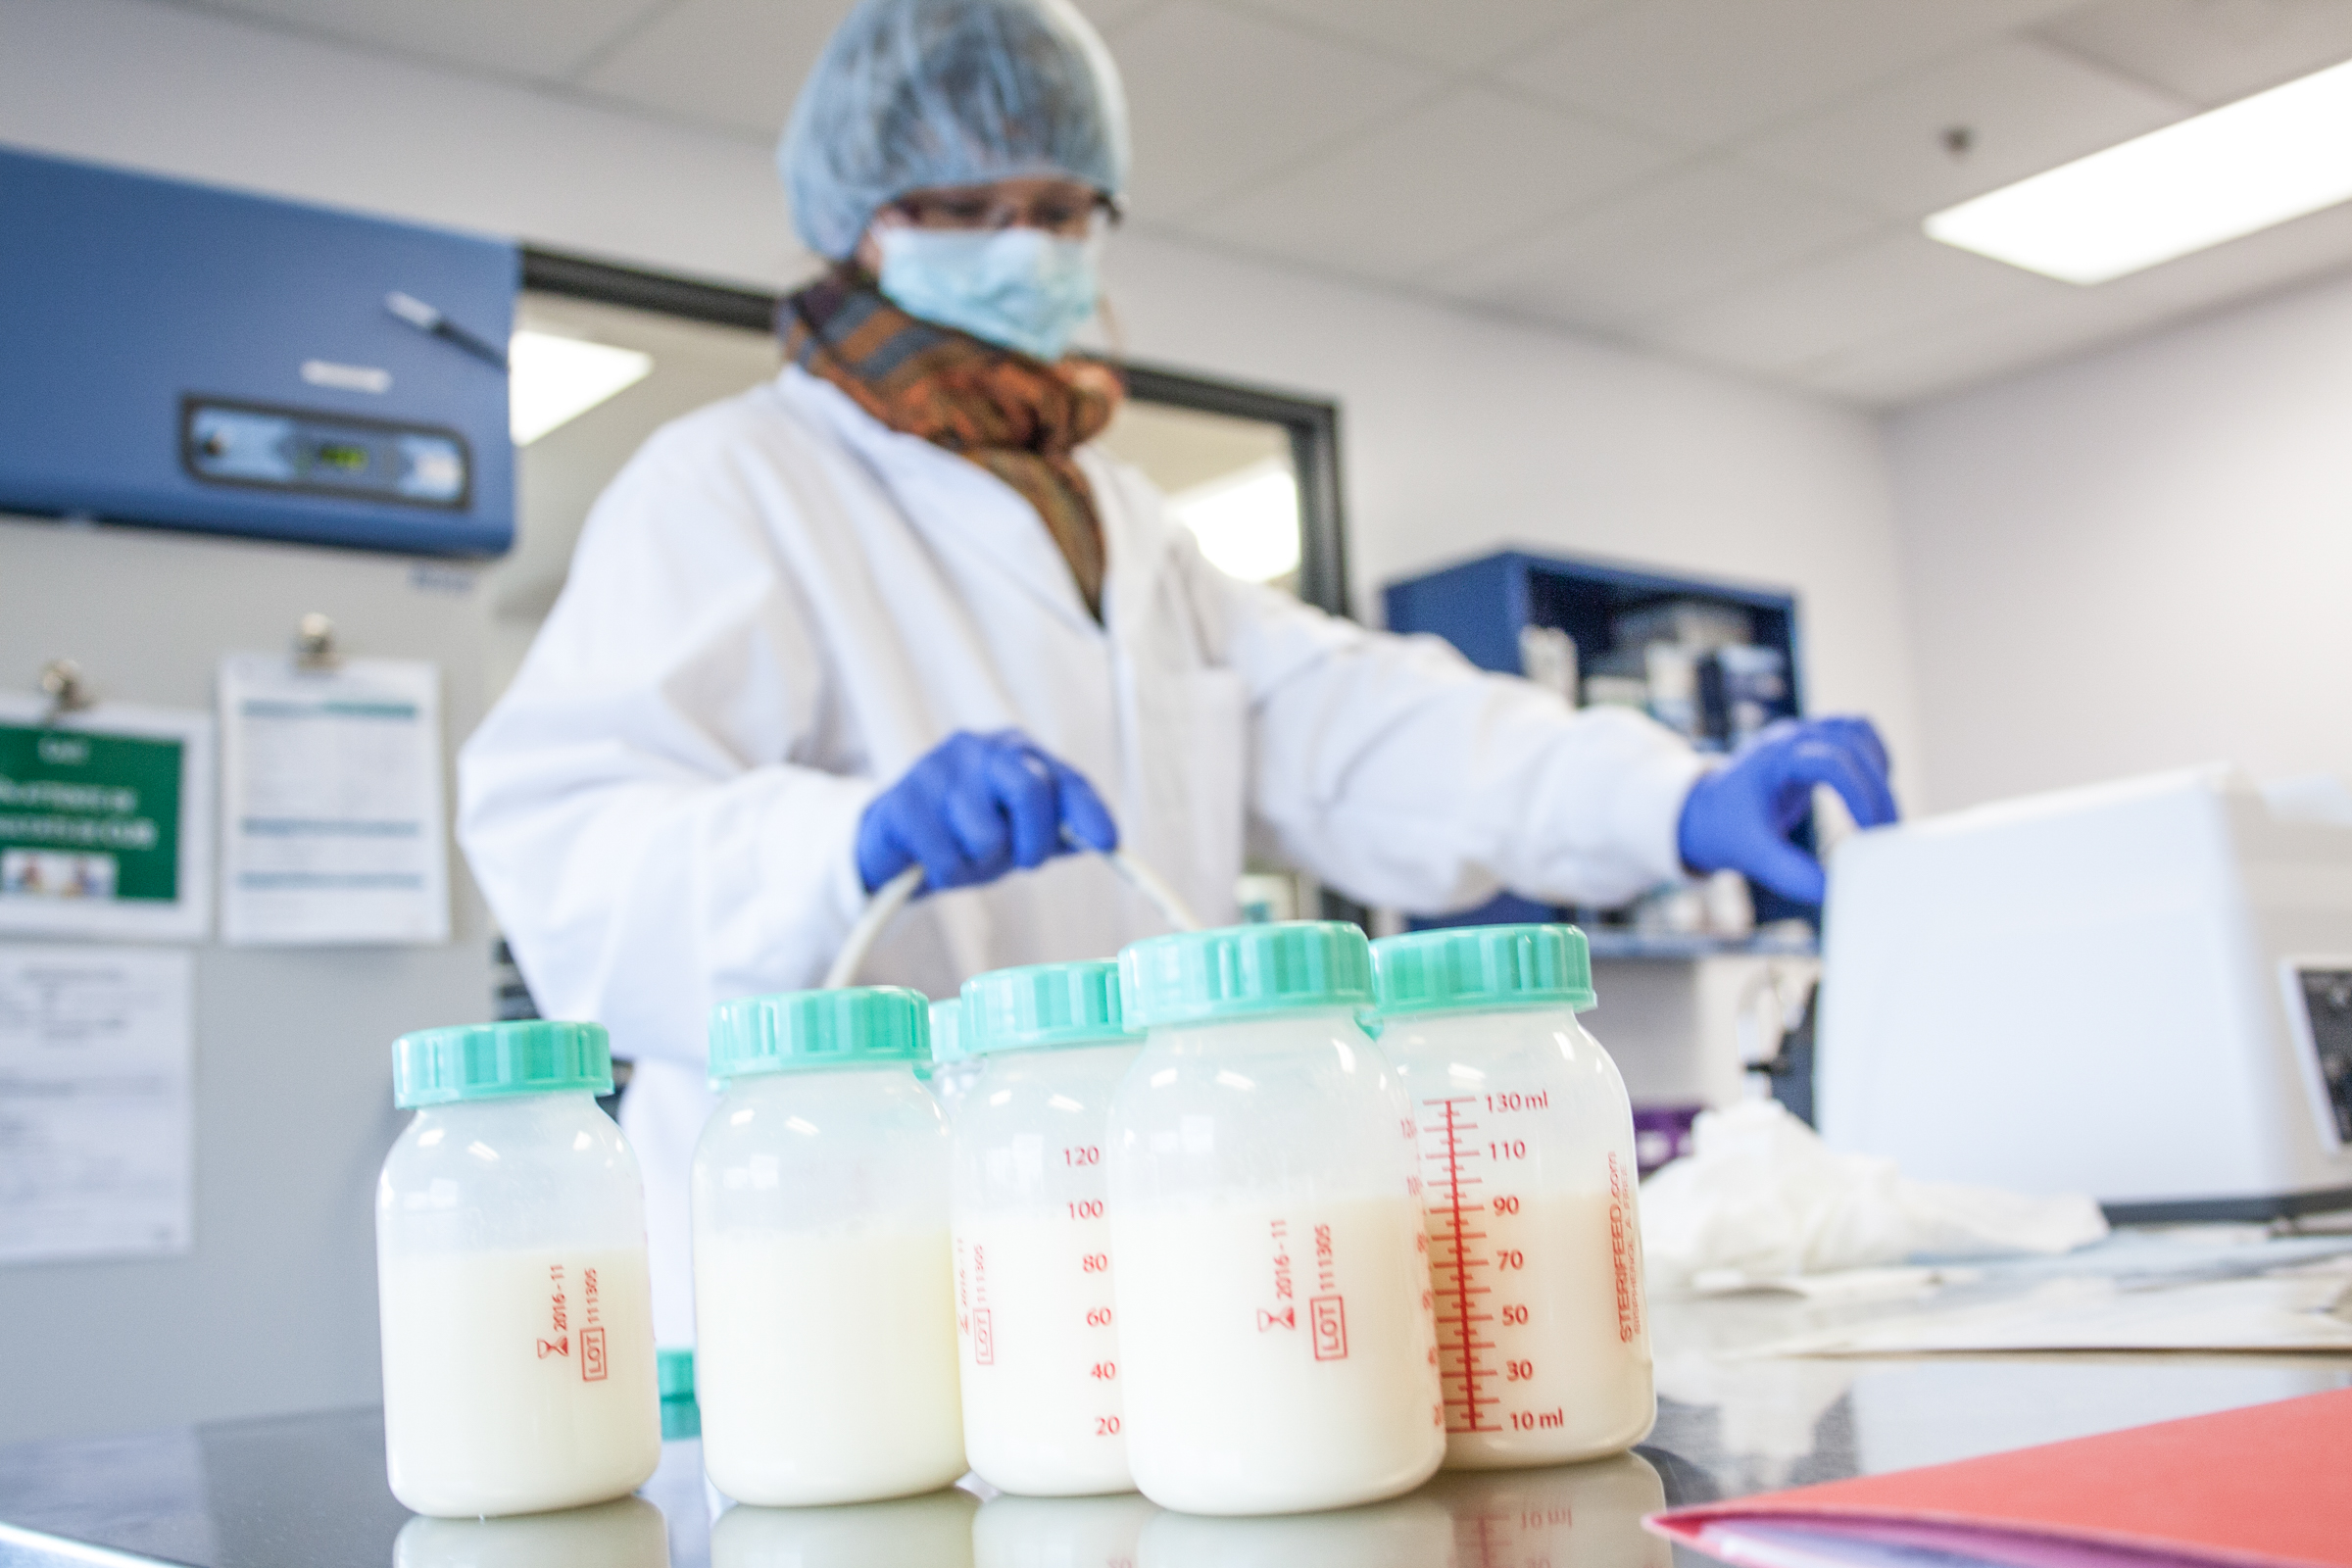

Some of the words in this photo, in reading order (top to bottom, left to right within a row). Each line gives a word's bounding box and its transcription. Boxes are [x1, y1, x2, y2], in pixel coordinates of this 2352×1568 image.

[1063, 1145, 1100, 1167] 120
[1488, 1139, 1526, 1161] 110
[1066, 1198, 1104, 1220] 100
[1493, 1195, 1520, 1216] 90
[1083, 1251, 1108, 1274] 80
[1314, 1223, 1336, 1291] 111305
[1496, 1250, 1524, 1271] 70
[584, 1267, 601, 1324] 111305
[1086, 1305, 1112, 1328] 60
[1501, 1303, 1530, 1326] 50
[977, 1314, 990, 1357] LOT
[1318, 1304, 1341, 1351] LOT
[586, 1335, 602, 1374] LOT
[1090, 1360, 1116, 1382] 40
[1506, 1358, 1534, 1382] 30
[1095, 1414, 1120, 1437] 20
